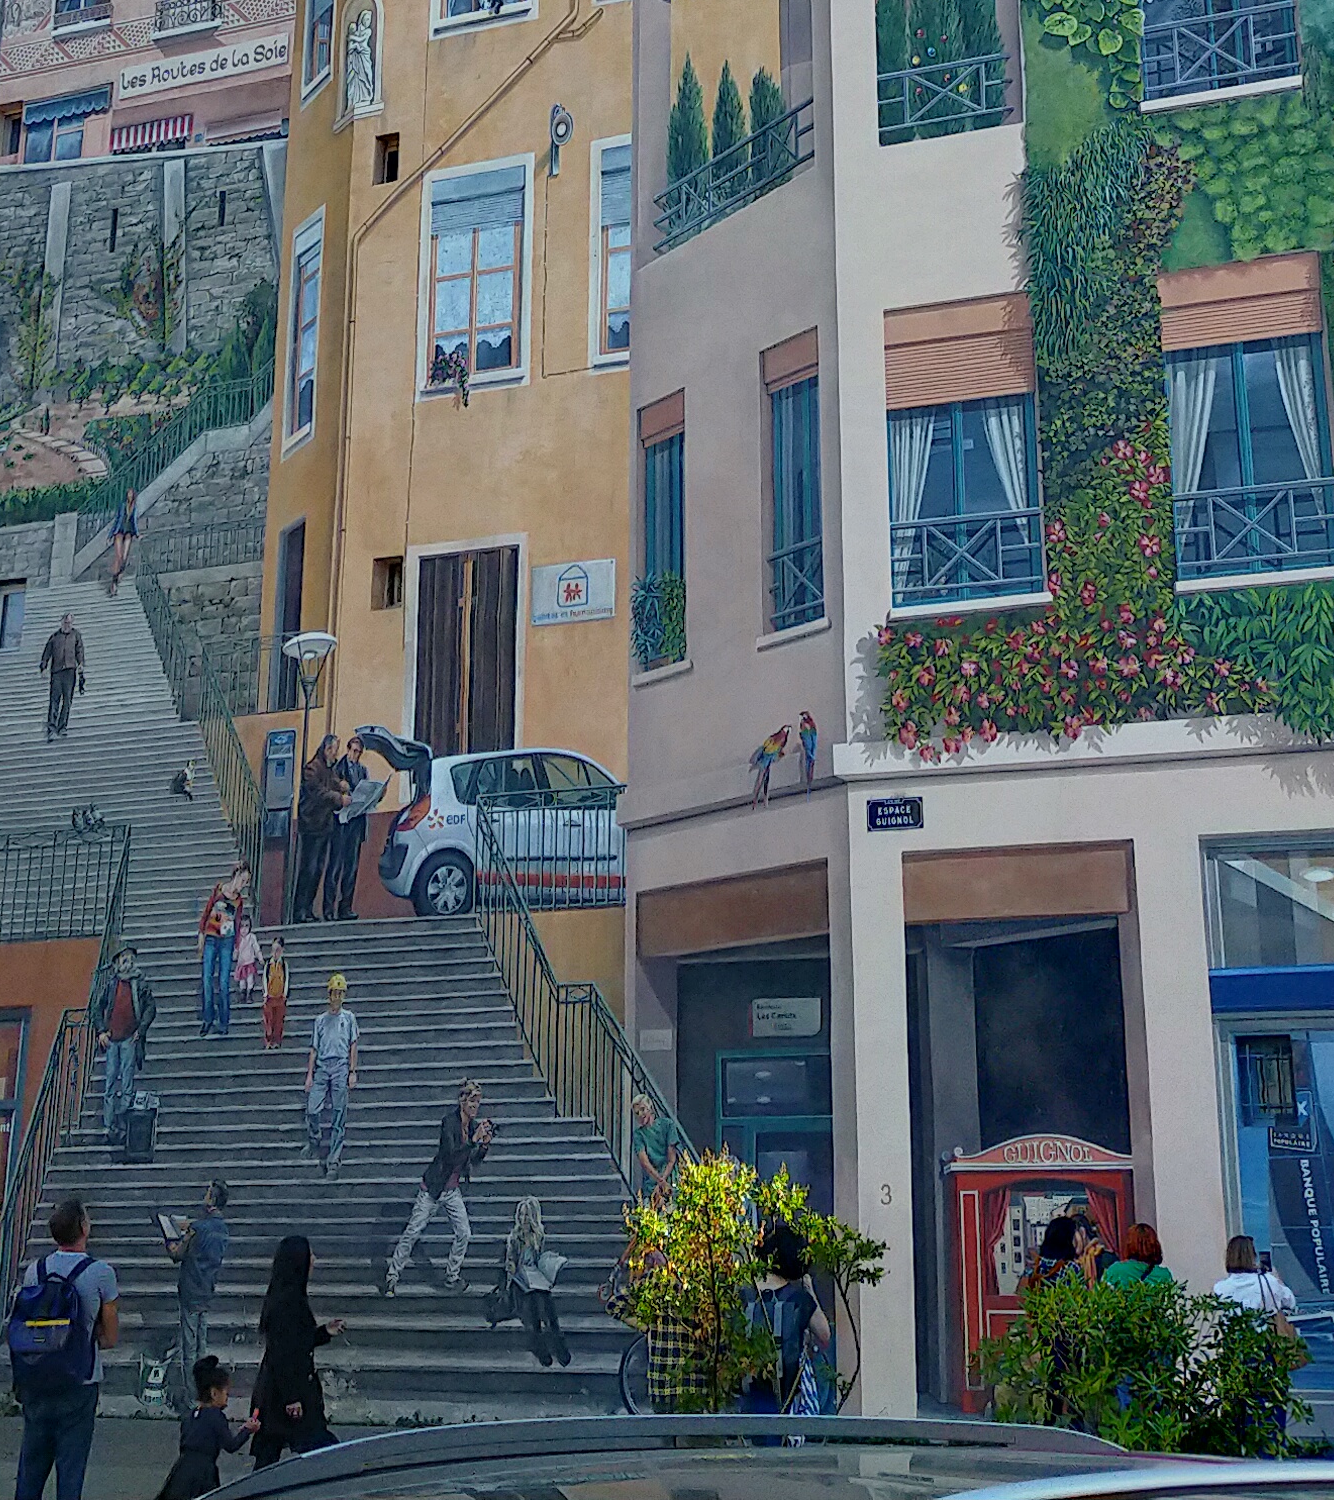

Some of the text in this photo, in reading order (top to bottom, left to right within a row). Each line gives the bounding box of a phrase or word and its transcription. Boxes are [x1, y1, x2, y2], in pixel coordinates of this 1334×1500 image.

[121, 72, 147, 90] Les
[150, 61, 206, 85] Routes
[210, 53, 228, 72] de
[253, 40, 287, 63] Soie
[875, 815, 914, 826] GUIGNOL
[877, 804, 911, 815] ESPACE
[1003, 1140, 1093, 1165] GUIGNOL
[879, 1184, 893, 1206] 3
[1299, 1158, 1331, 1295] BANQUE POPULAIRE
